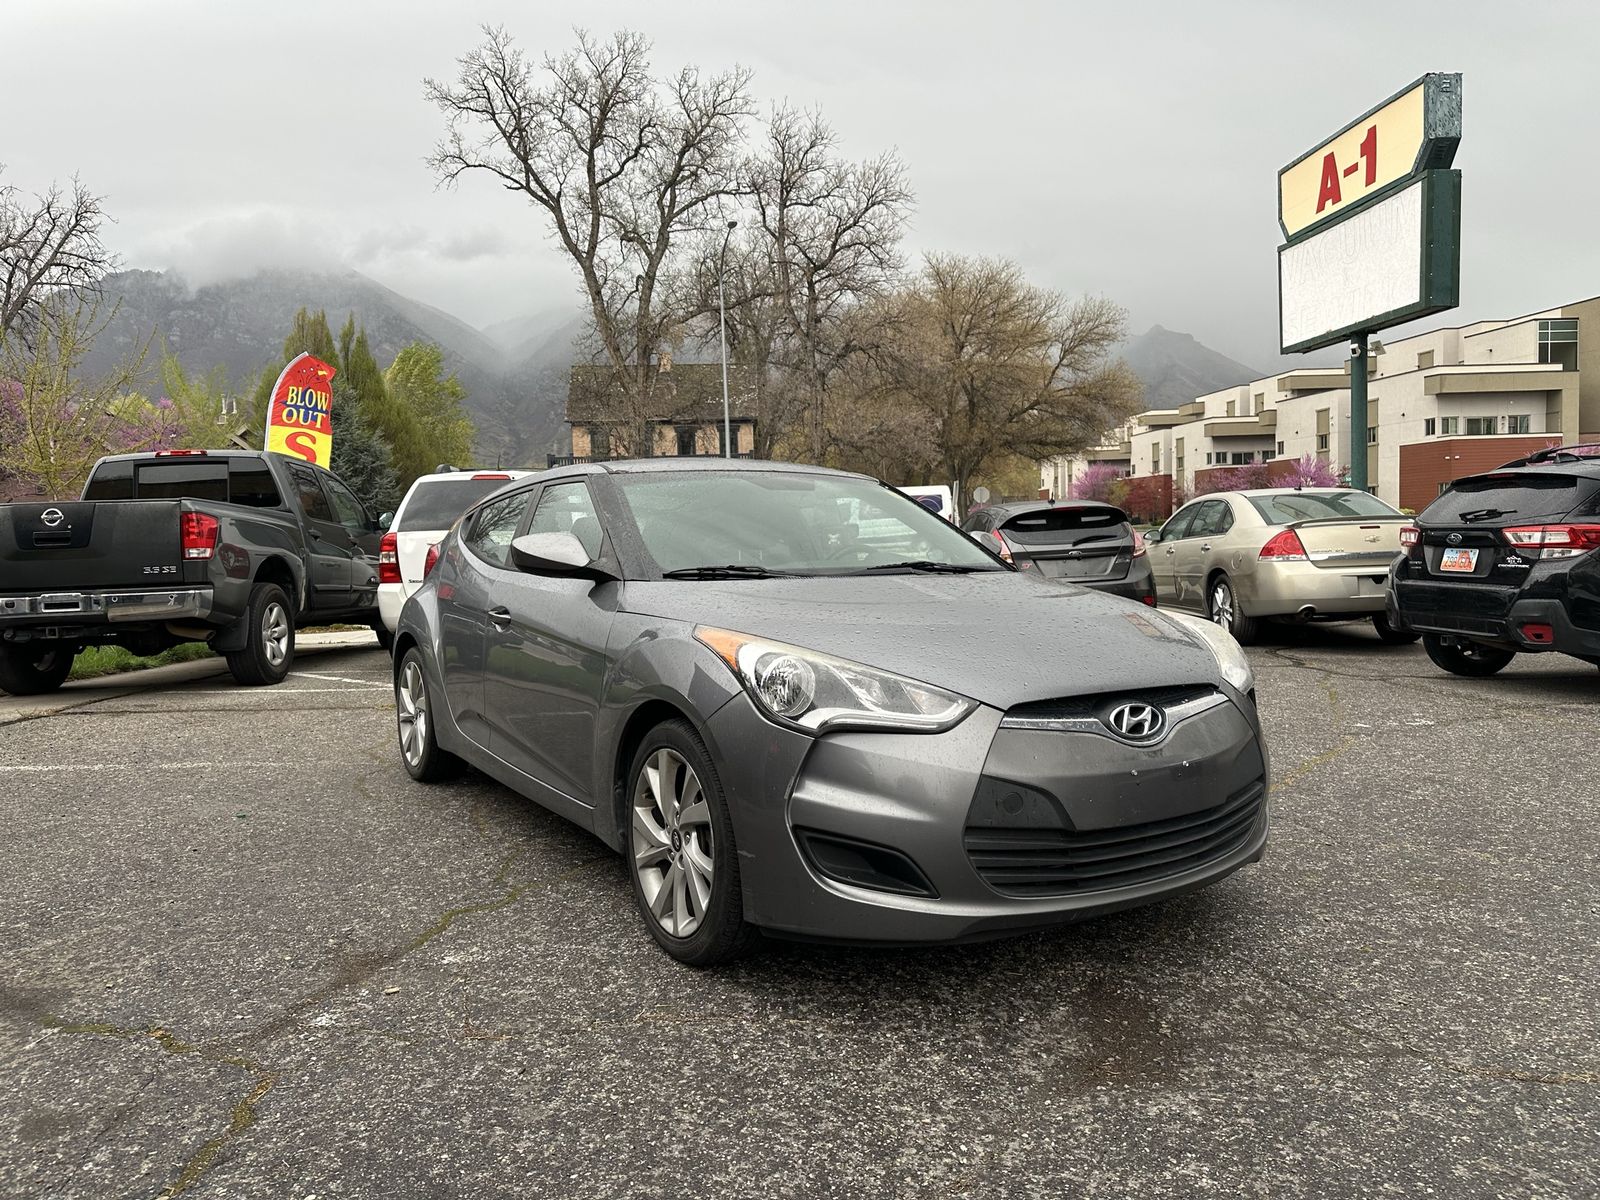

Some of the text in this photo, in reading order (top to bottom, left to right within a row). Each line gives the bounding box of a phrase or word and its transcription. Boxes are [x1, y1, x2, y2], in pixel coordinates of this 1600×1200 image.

[1315, 124, 1377, 214] A-1
[286, 386, 329, 412] BLOW
[281, 407, 326, 429] OUT
[284, 431, 317, 464] S
